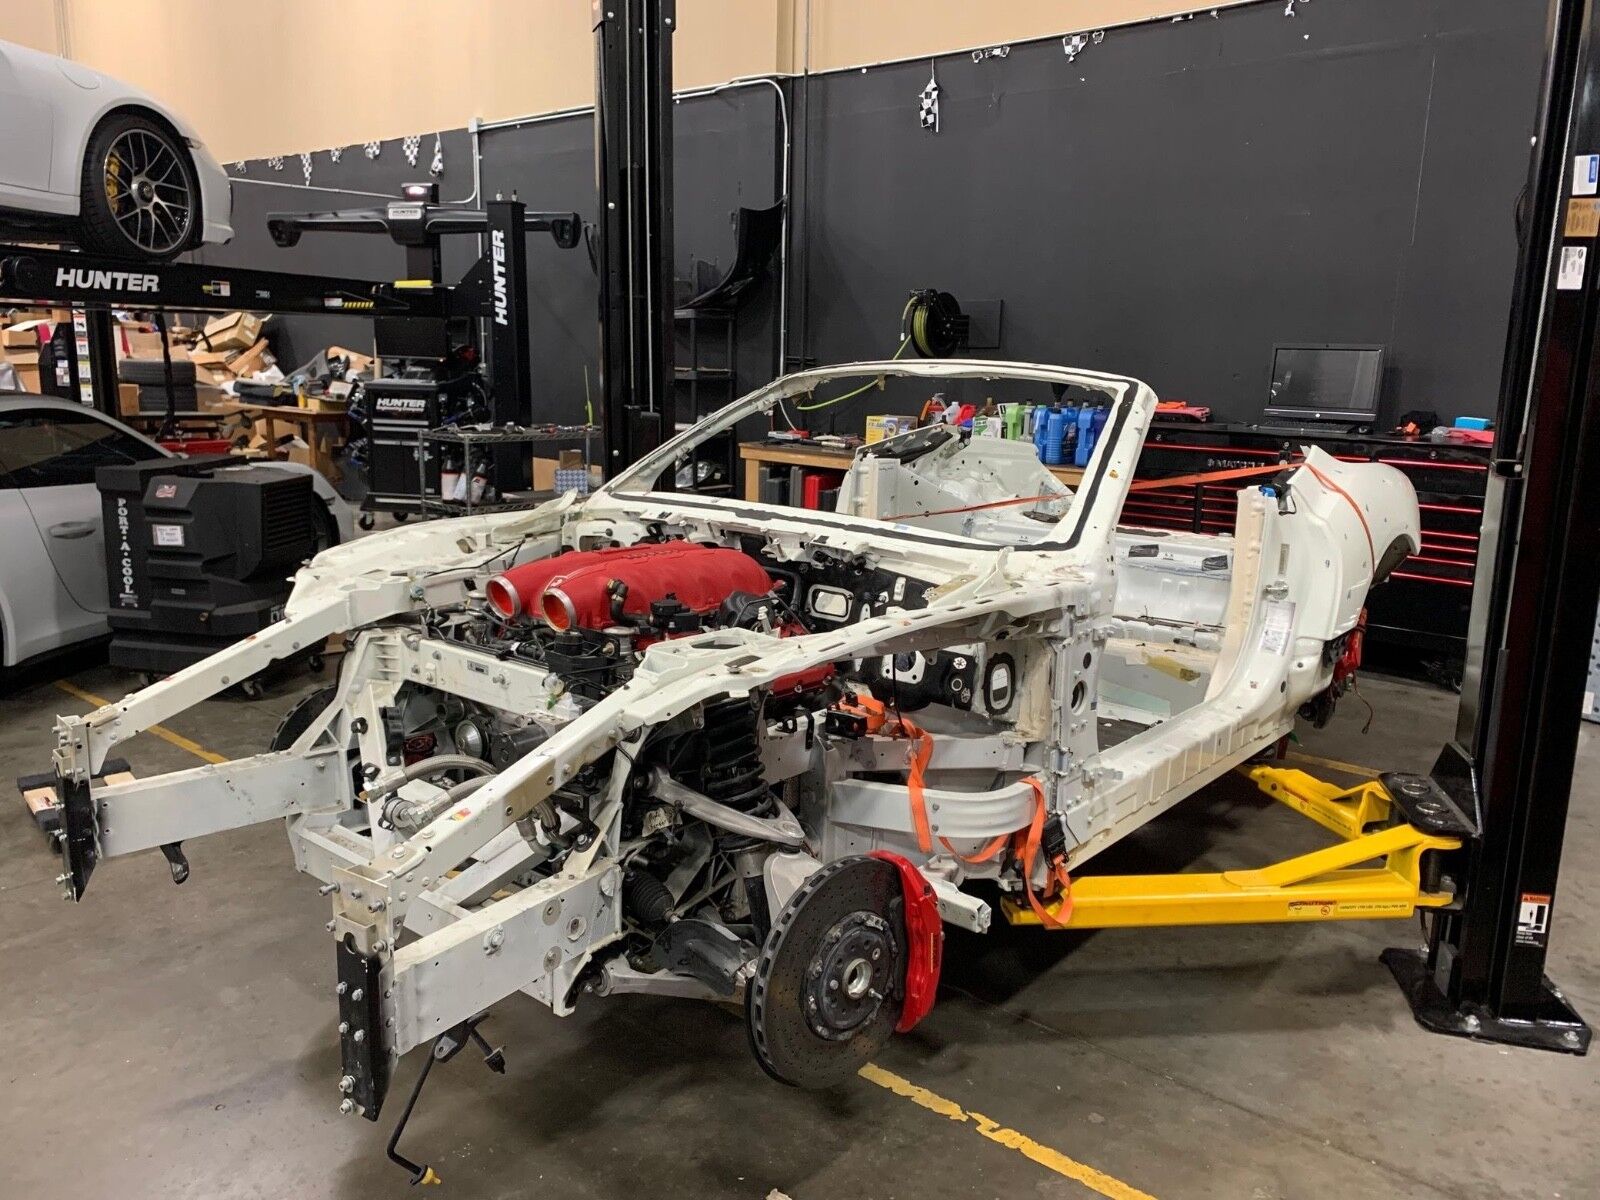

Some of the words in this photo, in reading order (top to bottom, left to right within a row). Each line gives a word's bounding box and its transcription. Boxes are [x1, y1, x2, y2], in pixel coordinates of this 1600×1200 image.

[56, 268, 160, 292] HUNTER
[492, 230, 508, 325] HUNTER
[376, 398, 426, 408] HUNTER
